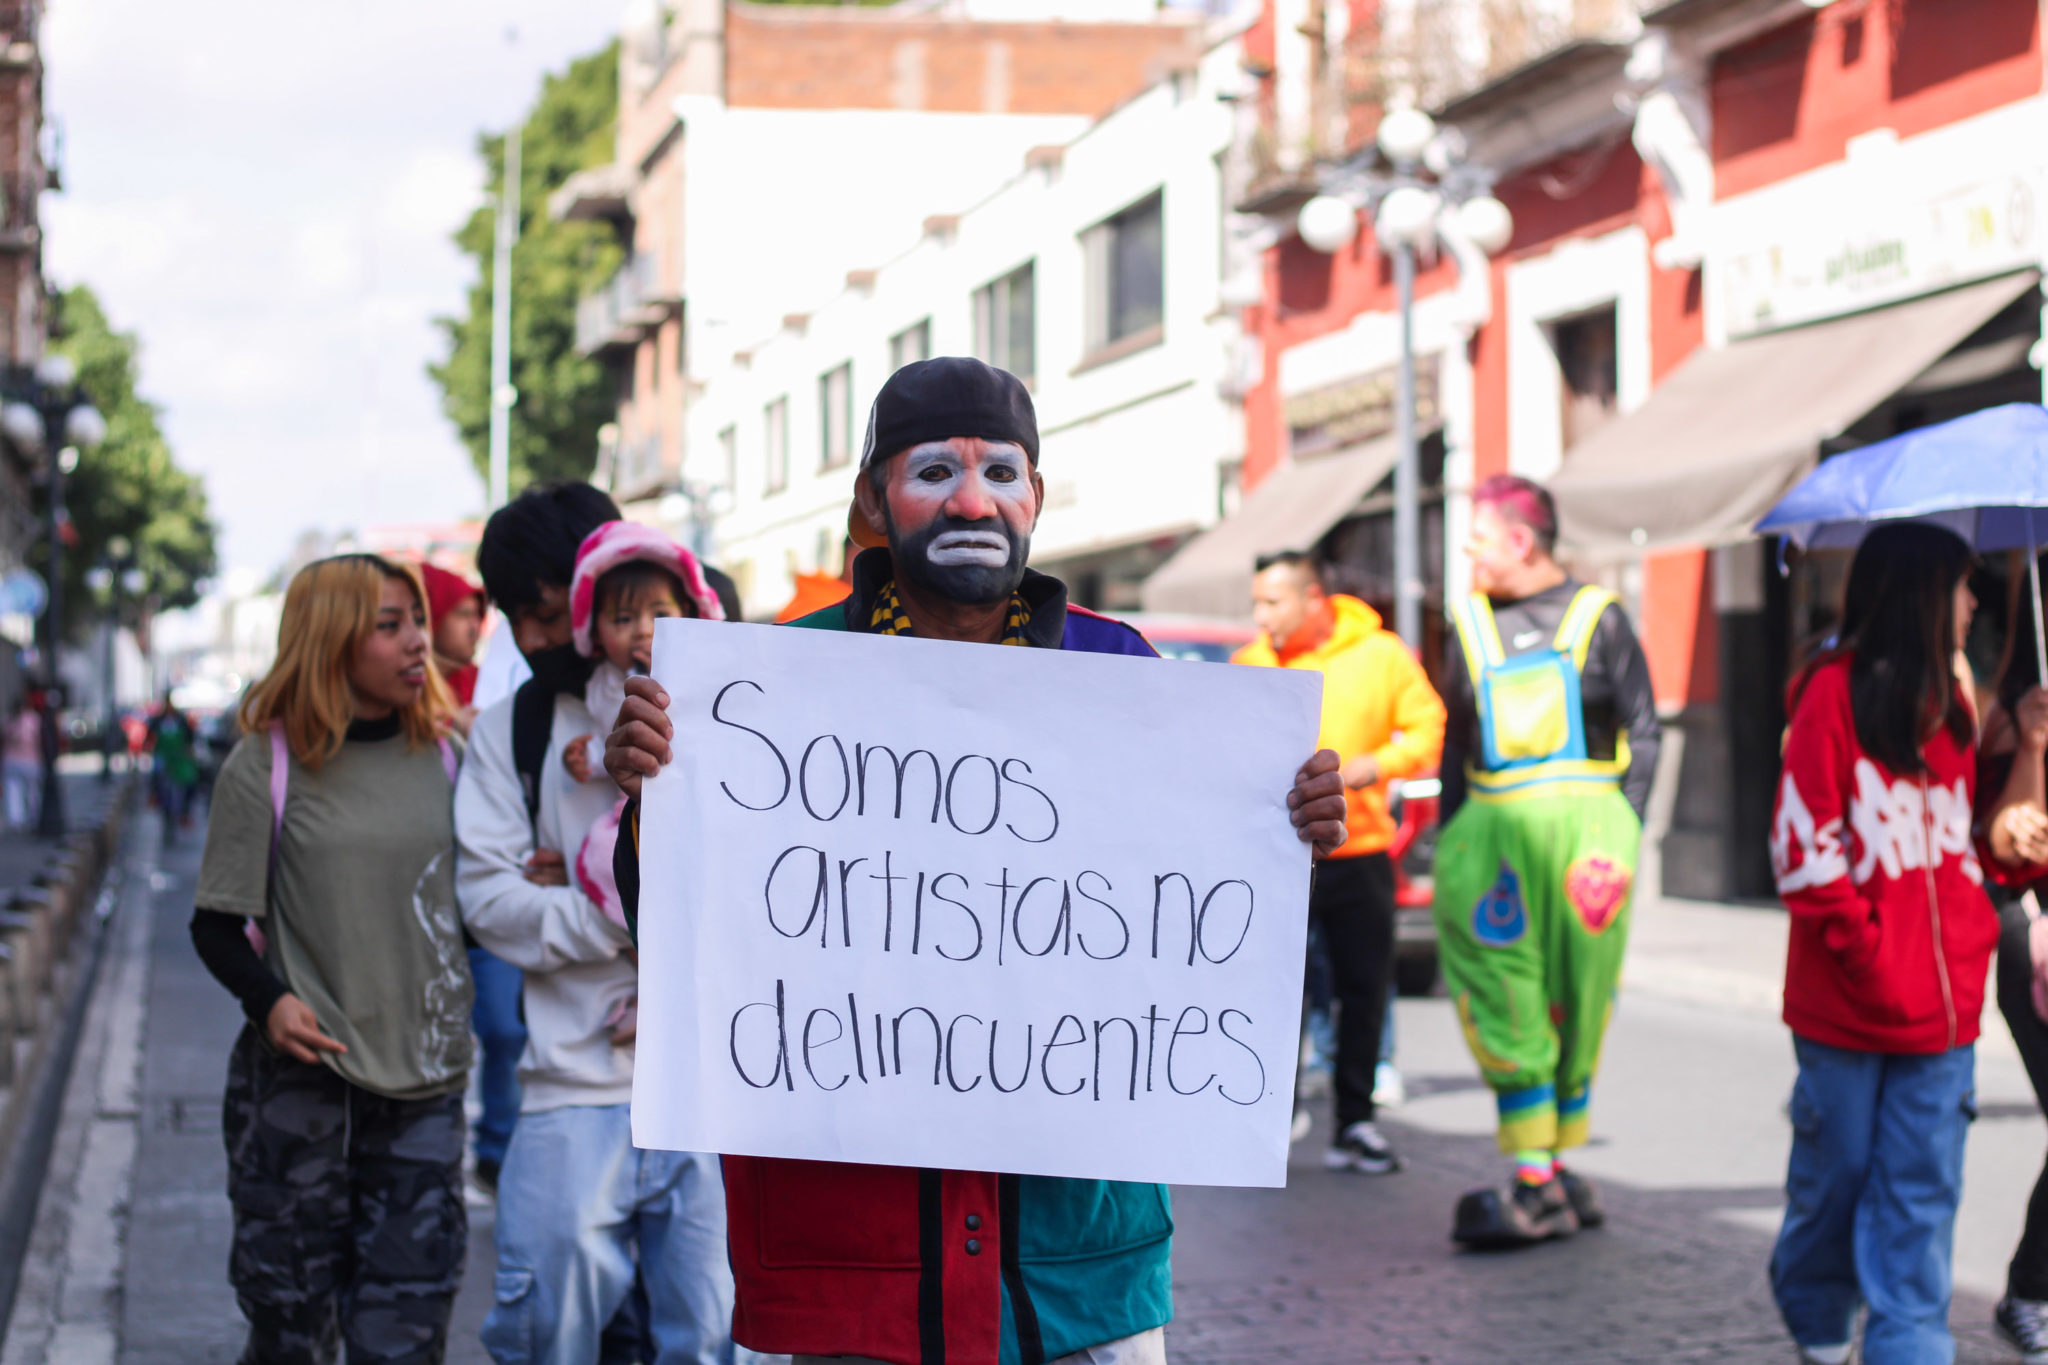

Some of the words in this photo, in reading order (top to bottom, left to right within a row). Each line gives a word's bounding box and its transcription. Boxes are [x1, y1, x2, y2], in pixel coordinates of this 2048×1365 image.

[711, 680, 1059, 842] Somos
[765, 845, 1130, 965] artistas
[1153, 872, 1254, 965] no
